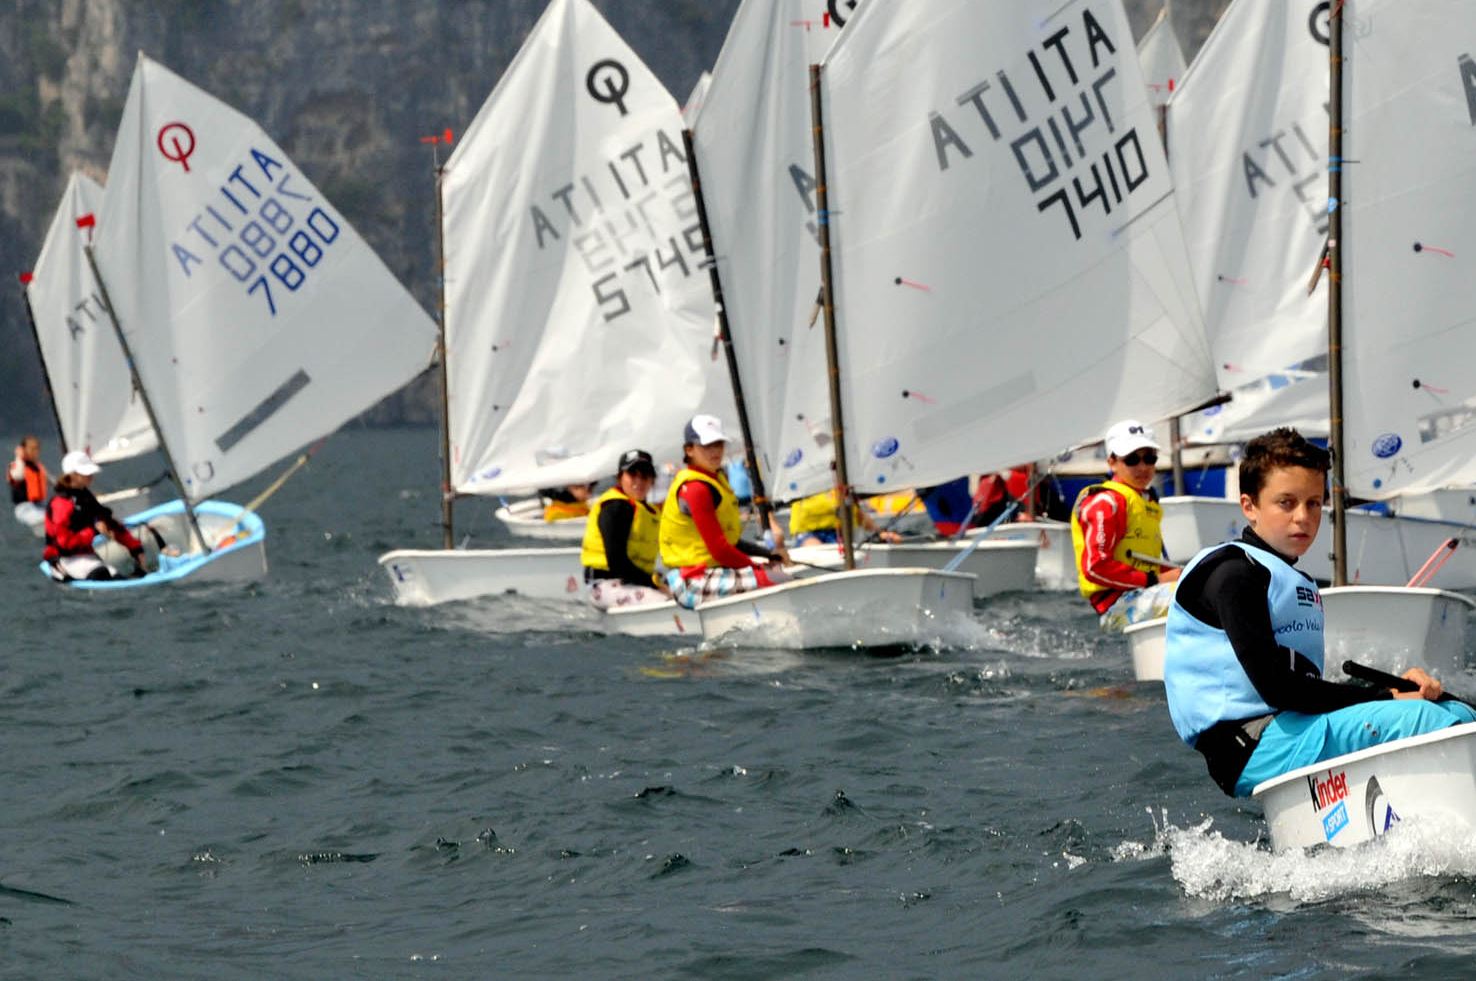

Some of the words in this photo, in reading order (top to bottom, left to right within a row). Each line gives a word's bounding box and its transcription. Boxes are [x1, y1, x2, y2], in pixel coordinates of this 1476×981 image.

[1037, 126, 1149, 240] 7410
[247, 207, 340, 316] 7880
[1307, 768, 1349, 813] Kinder
